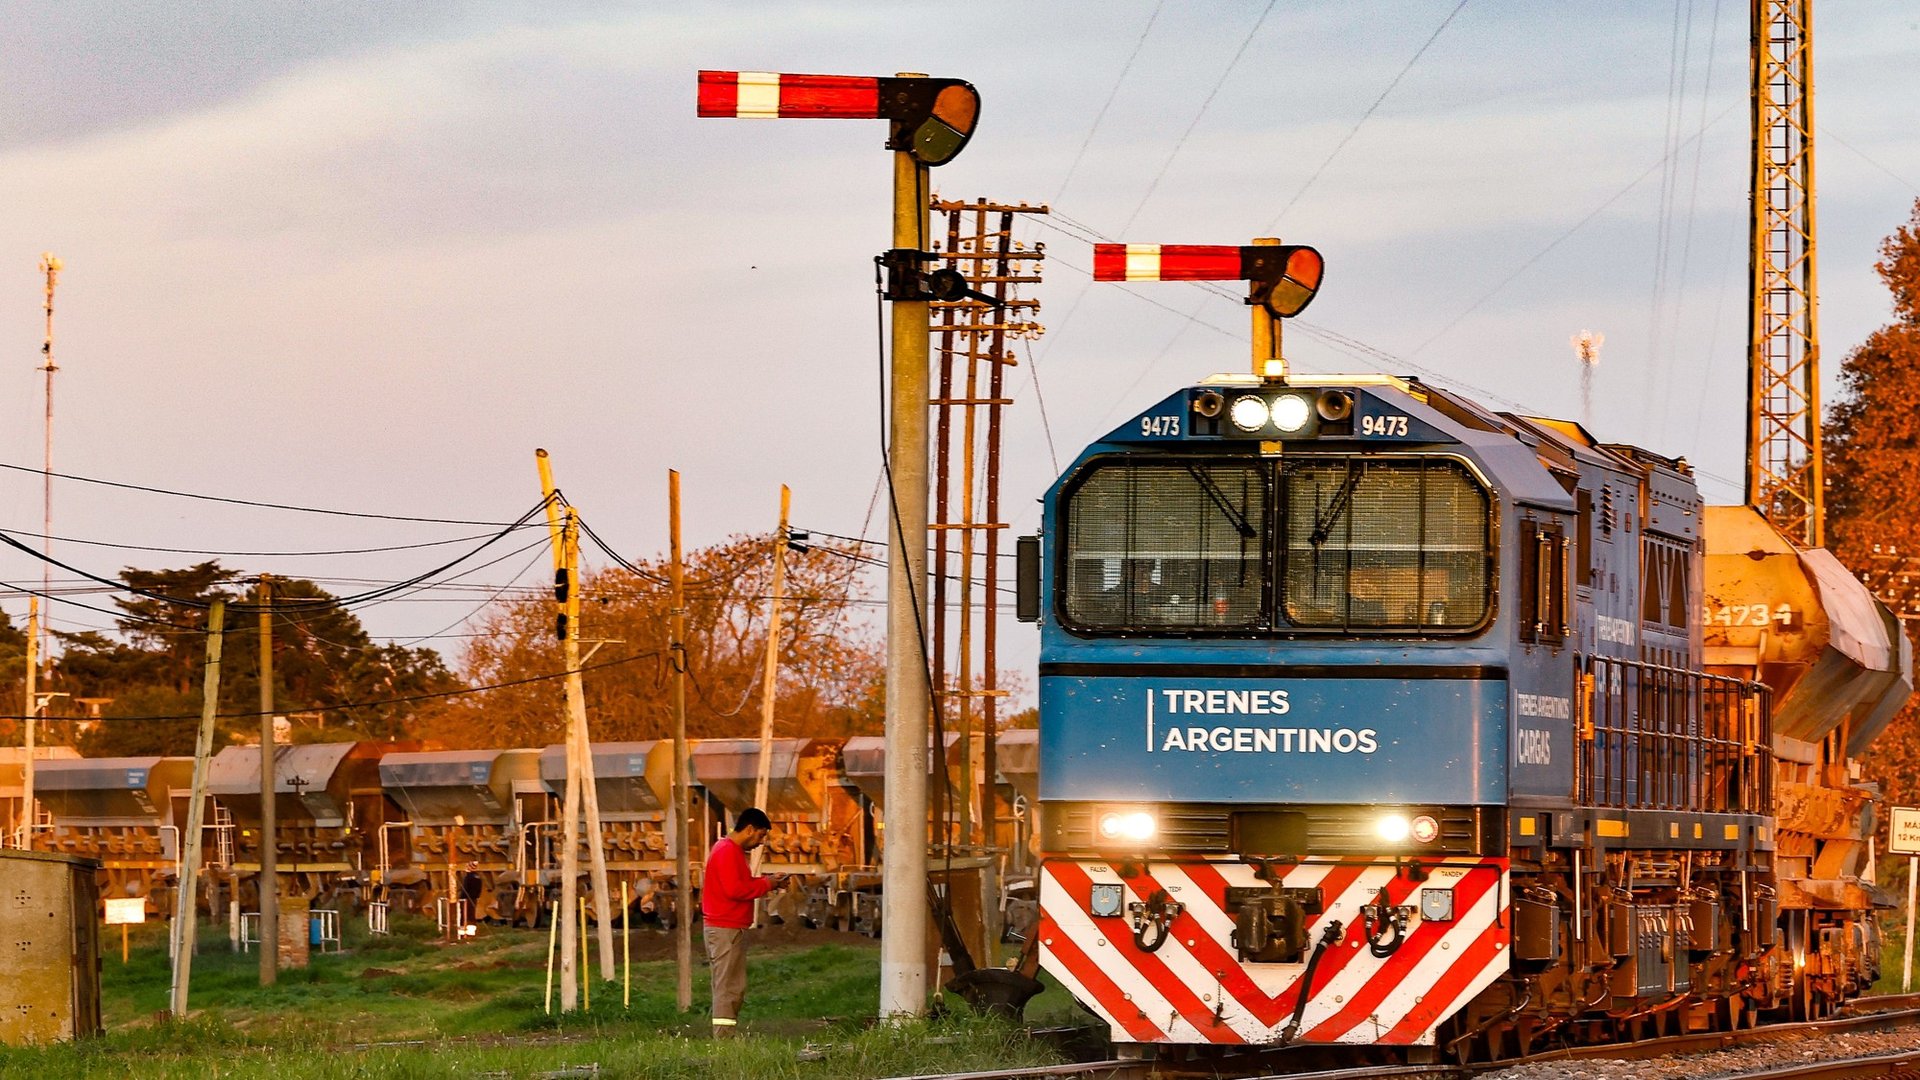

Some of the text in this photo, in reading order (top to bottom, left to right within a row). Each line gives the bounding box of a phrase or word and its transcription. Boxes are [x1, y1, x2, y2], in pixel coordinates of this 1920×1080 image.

[1141, 416, 1180, 436] 9473
[1362, 415, 1408, 436] 9473
[1163, 689, 1290, 714] TRENES
[1162, 727, 1379, 754] ARGENTINOS
[1518, 728, 1551, 765] CARGAS
[1898, 833, 1908, 841] 12
